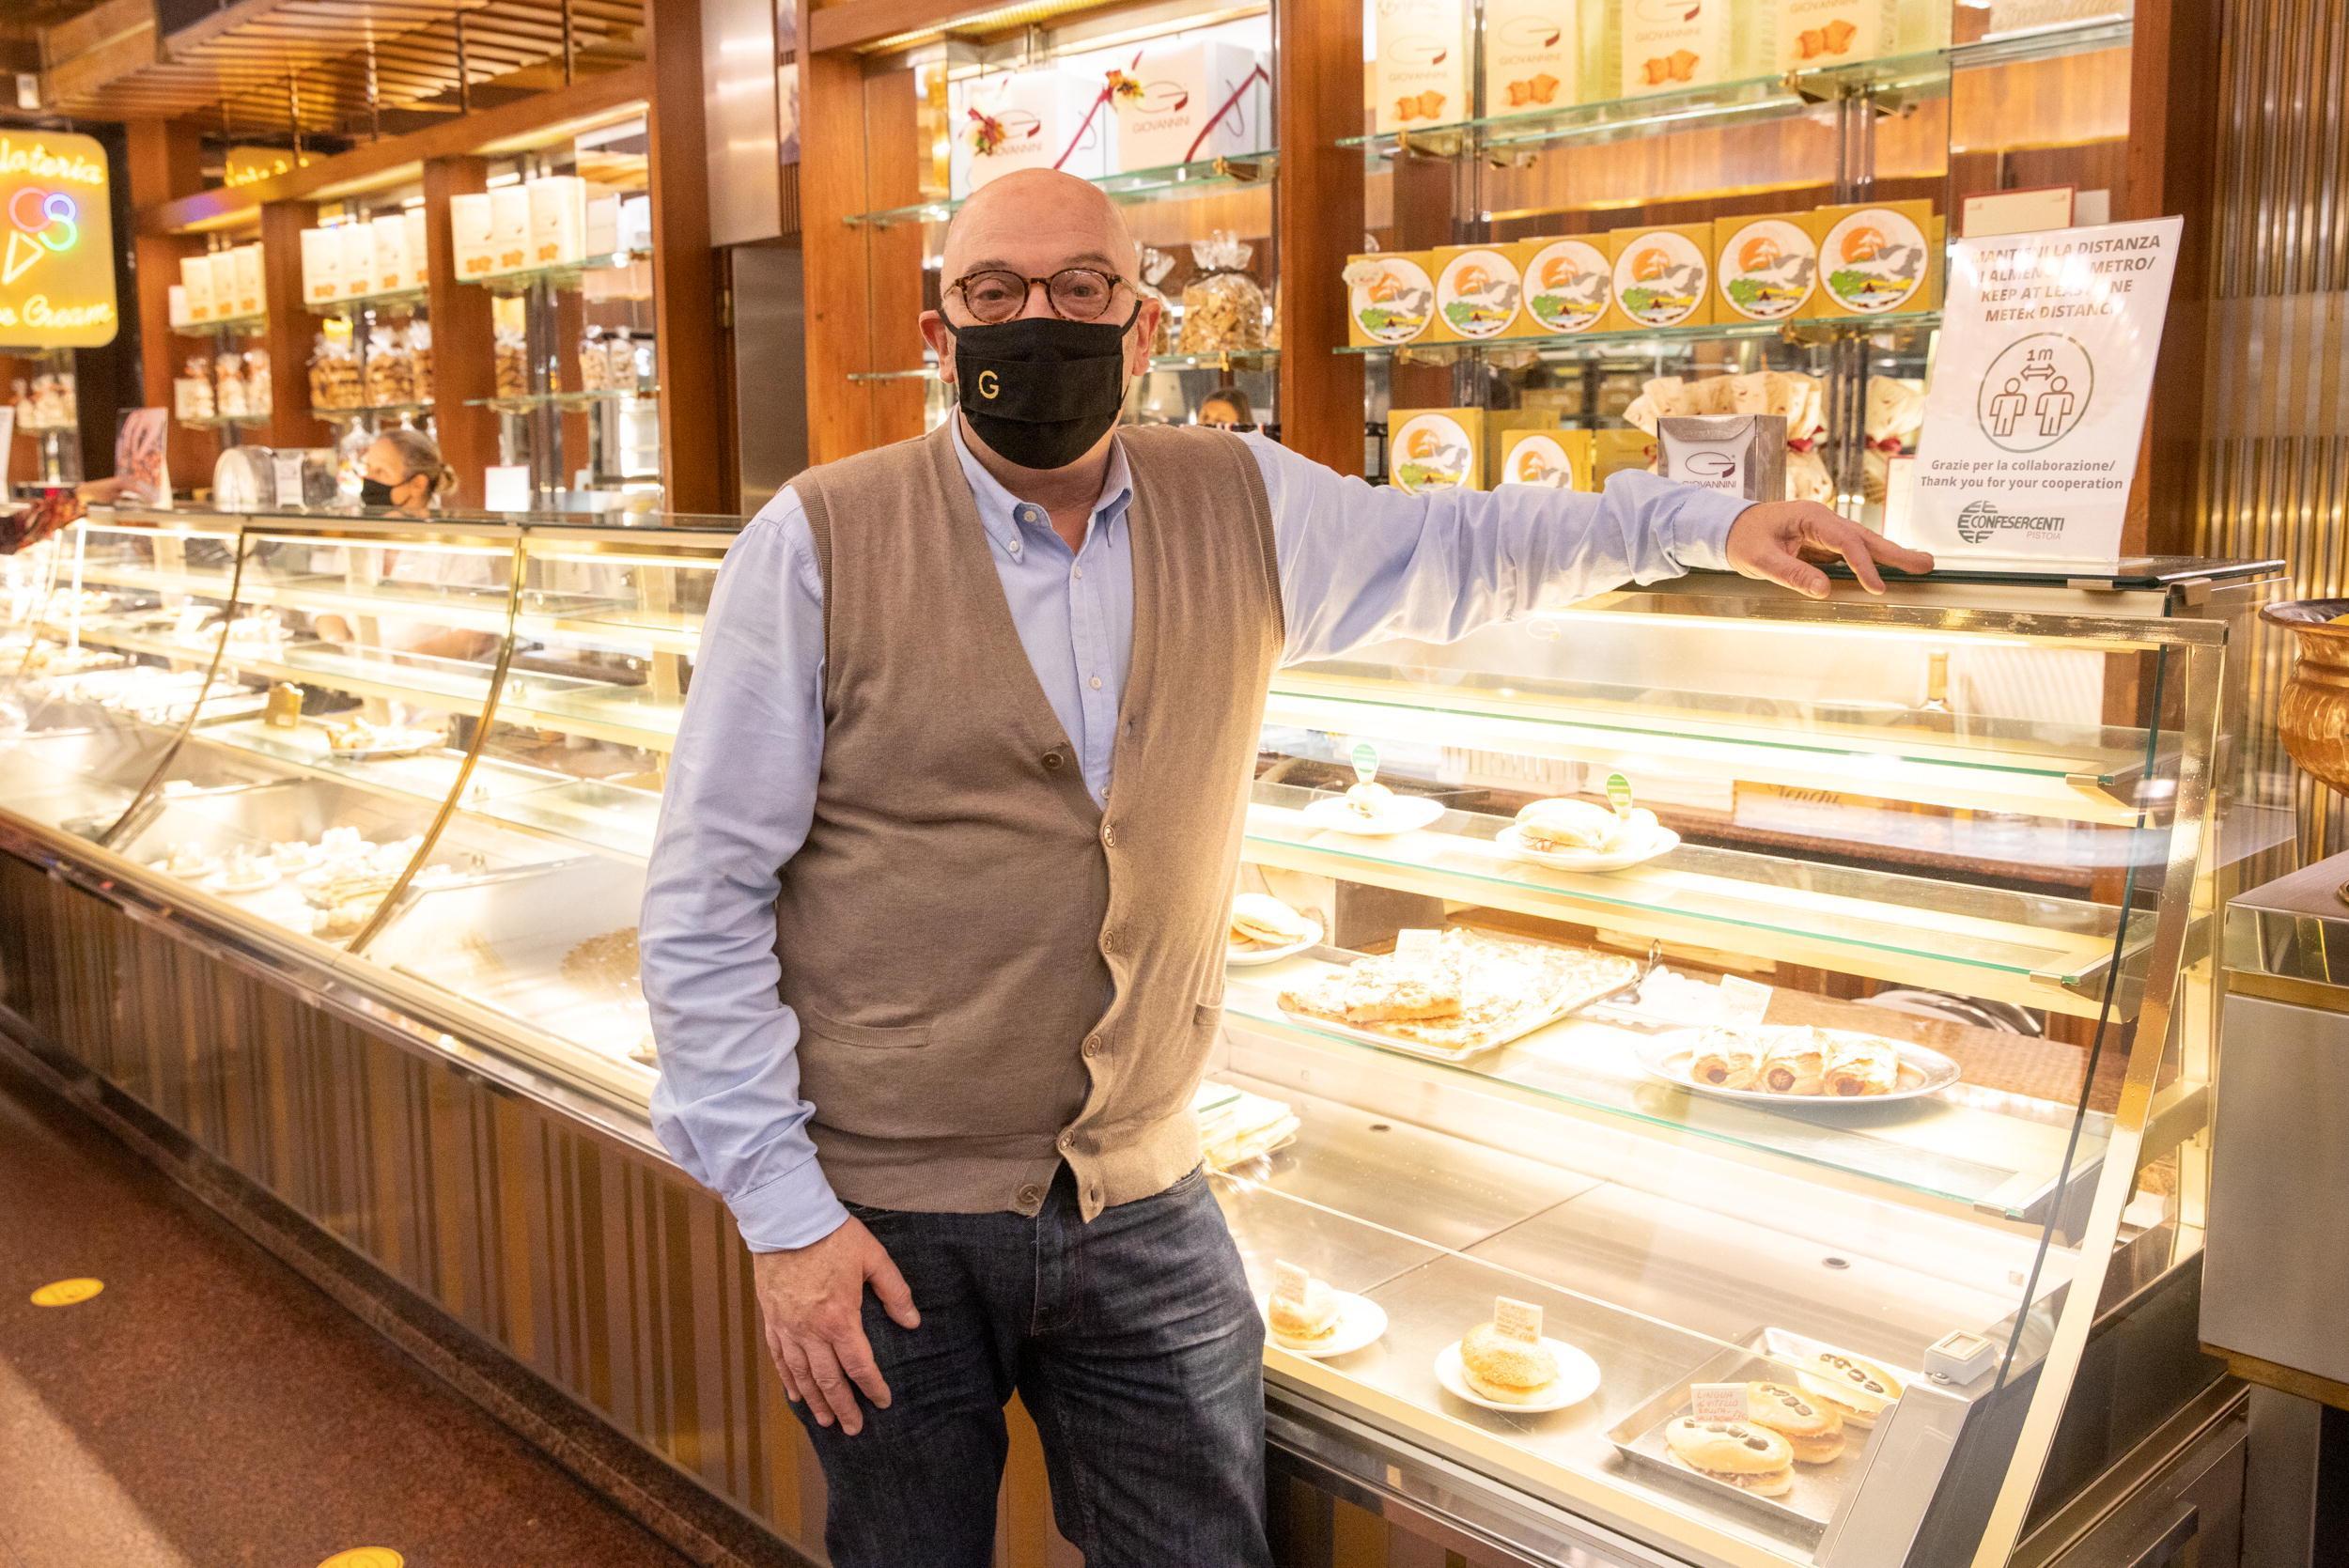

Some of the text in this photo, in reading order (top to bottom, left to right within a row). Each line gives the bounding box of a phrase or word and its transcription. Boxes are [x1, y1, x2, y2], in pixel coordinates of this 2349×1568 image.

[1132, 116, 1190, 134] GIOVANNINI
[0, 138, 104, 184] lateria
[2053, 242, 2072, 257] LA
[2077, 235, 2161, 255] DISTANZA
[1989, 267, 2050, 283] ALMEN
[2090, 256, 2156, 274] METRO/
[1981, 289, 2017, 303] KEEP
[2020, 287, 2042, 301] AT
[1984, 303, 2121, 322] METER DISTANC
[979, 370, 999, 399] G
[1931, 459, 2116, 473] Grazie per la collaborazione/
[1921, 476, 2123, 491] Thank you for your cooperation
[1971, 515, 2064, 531] CONFESERCENTI
[2027, 531, 2061, 540] PISTOIA
